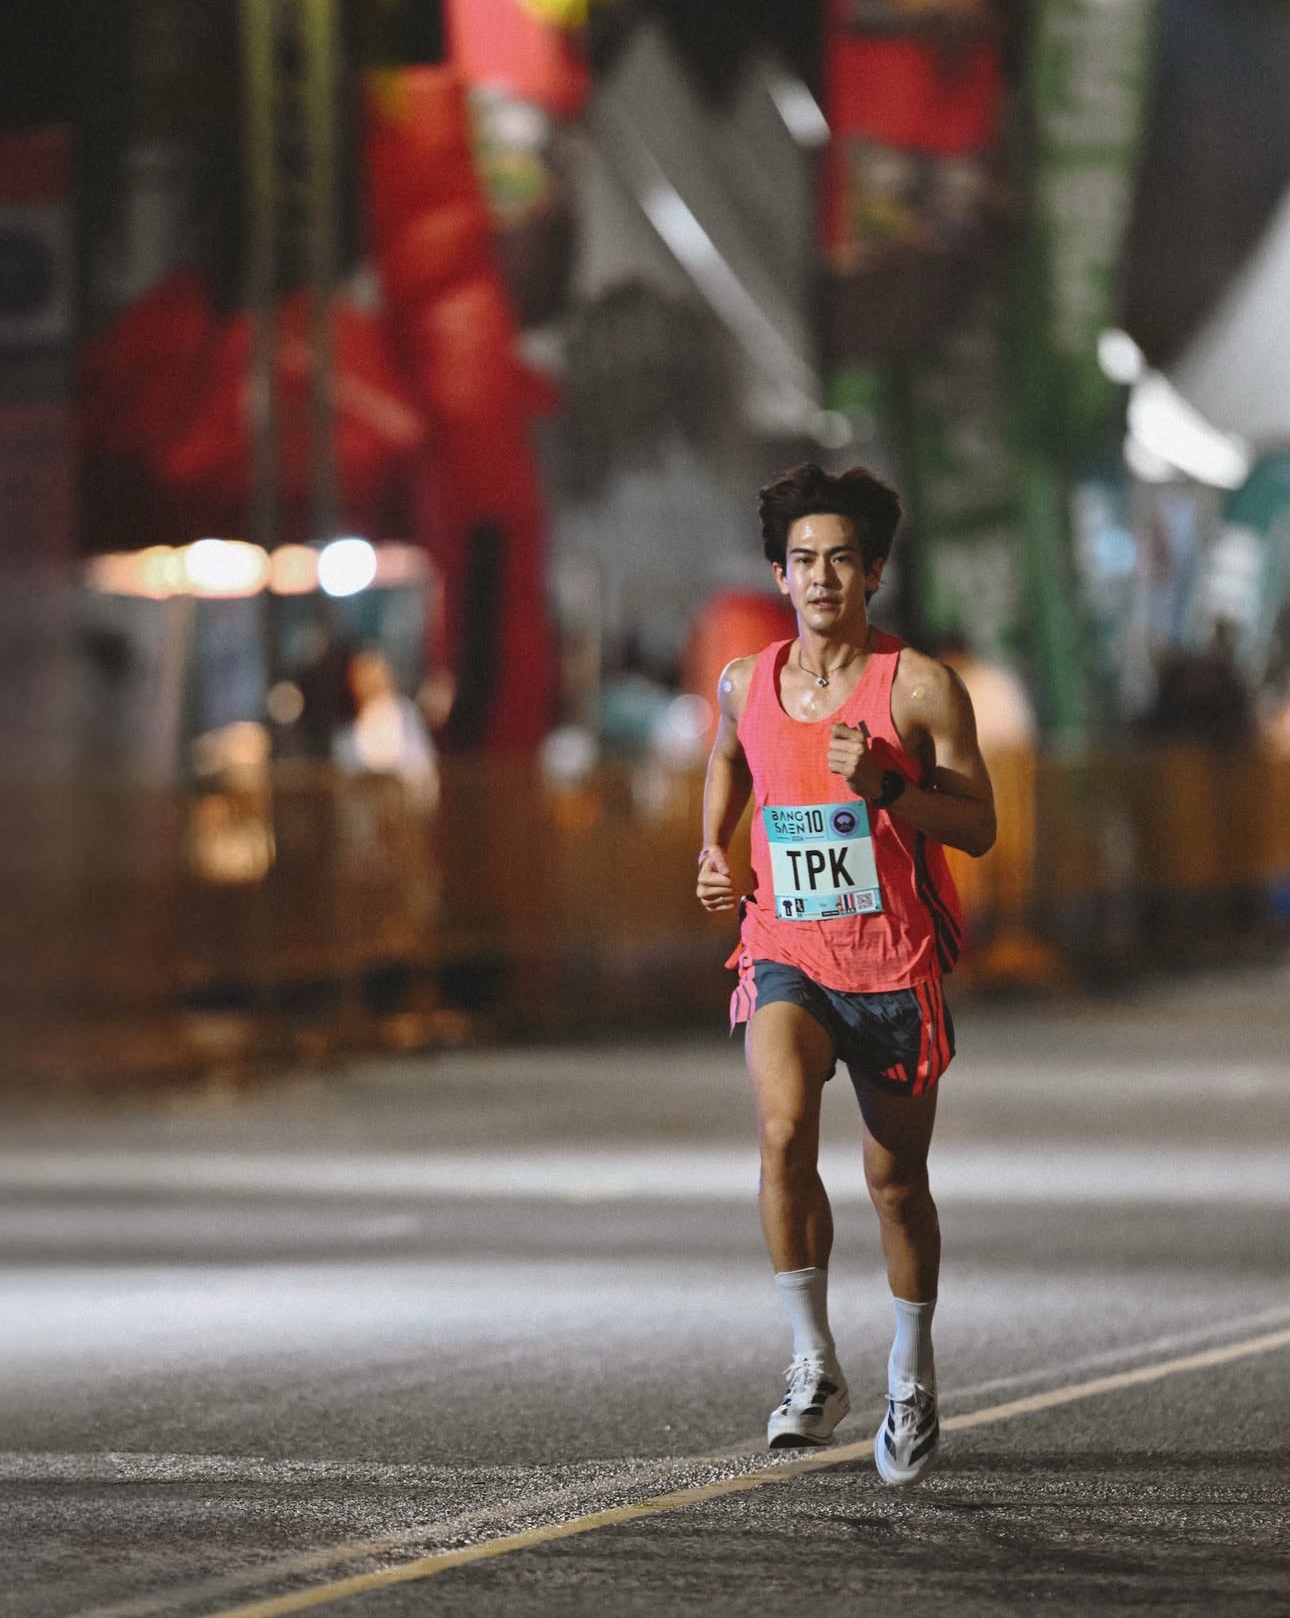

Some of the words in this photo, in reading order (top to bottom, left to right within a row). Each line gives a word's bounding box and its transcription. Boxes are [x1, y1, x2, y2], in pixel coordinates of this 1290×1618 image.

[771, 810, 803, 821] BANG
[804, 810, 823, 833] 10
[774, 822, 805, 834] SAEN
[786, 847, 855, 890] TPK
